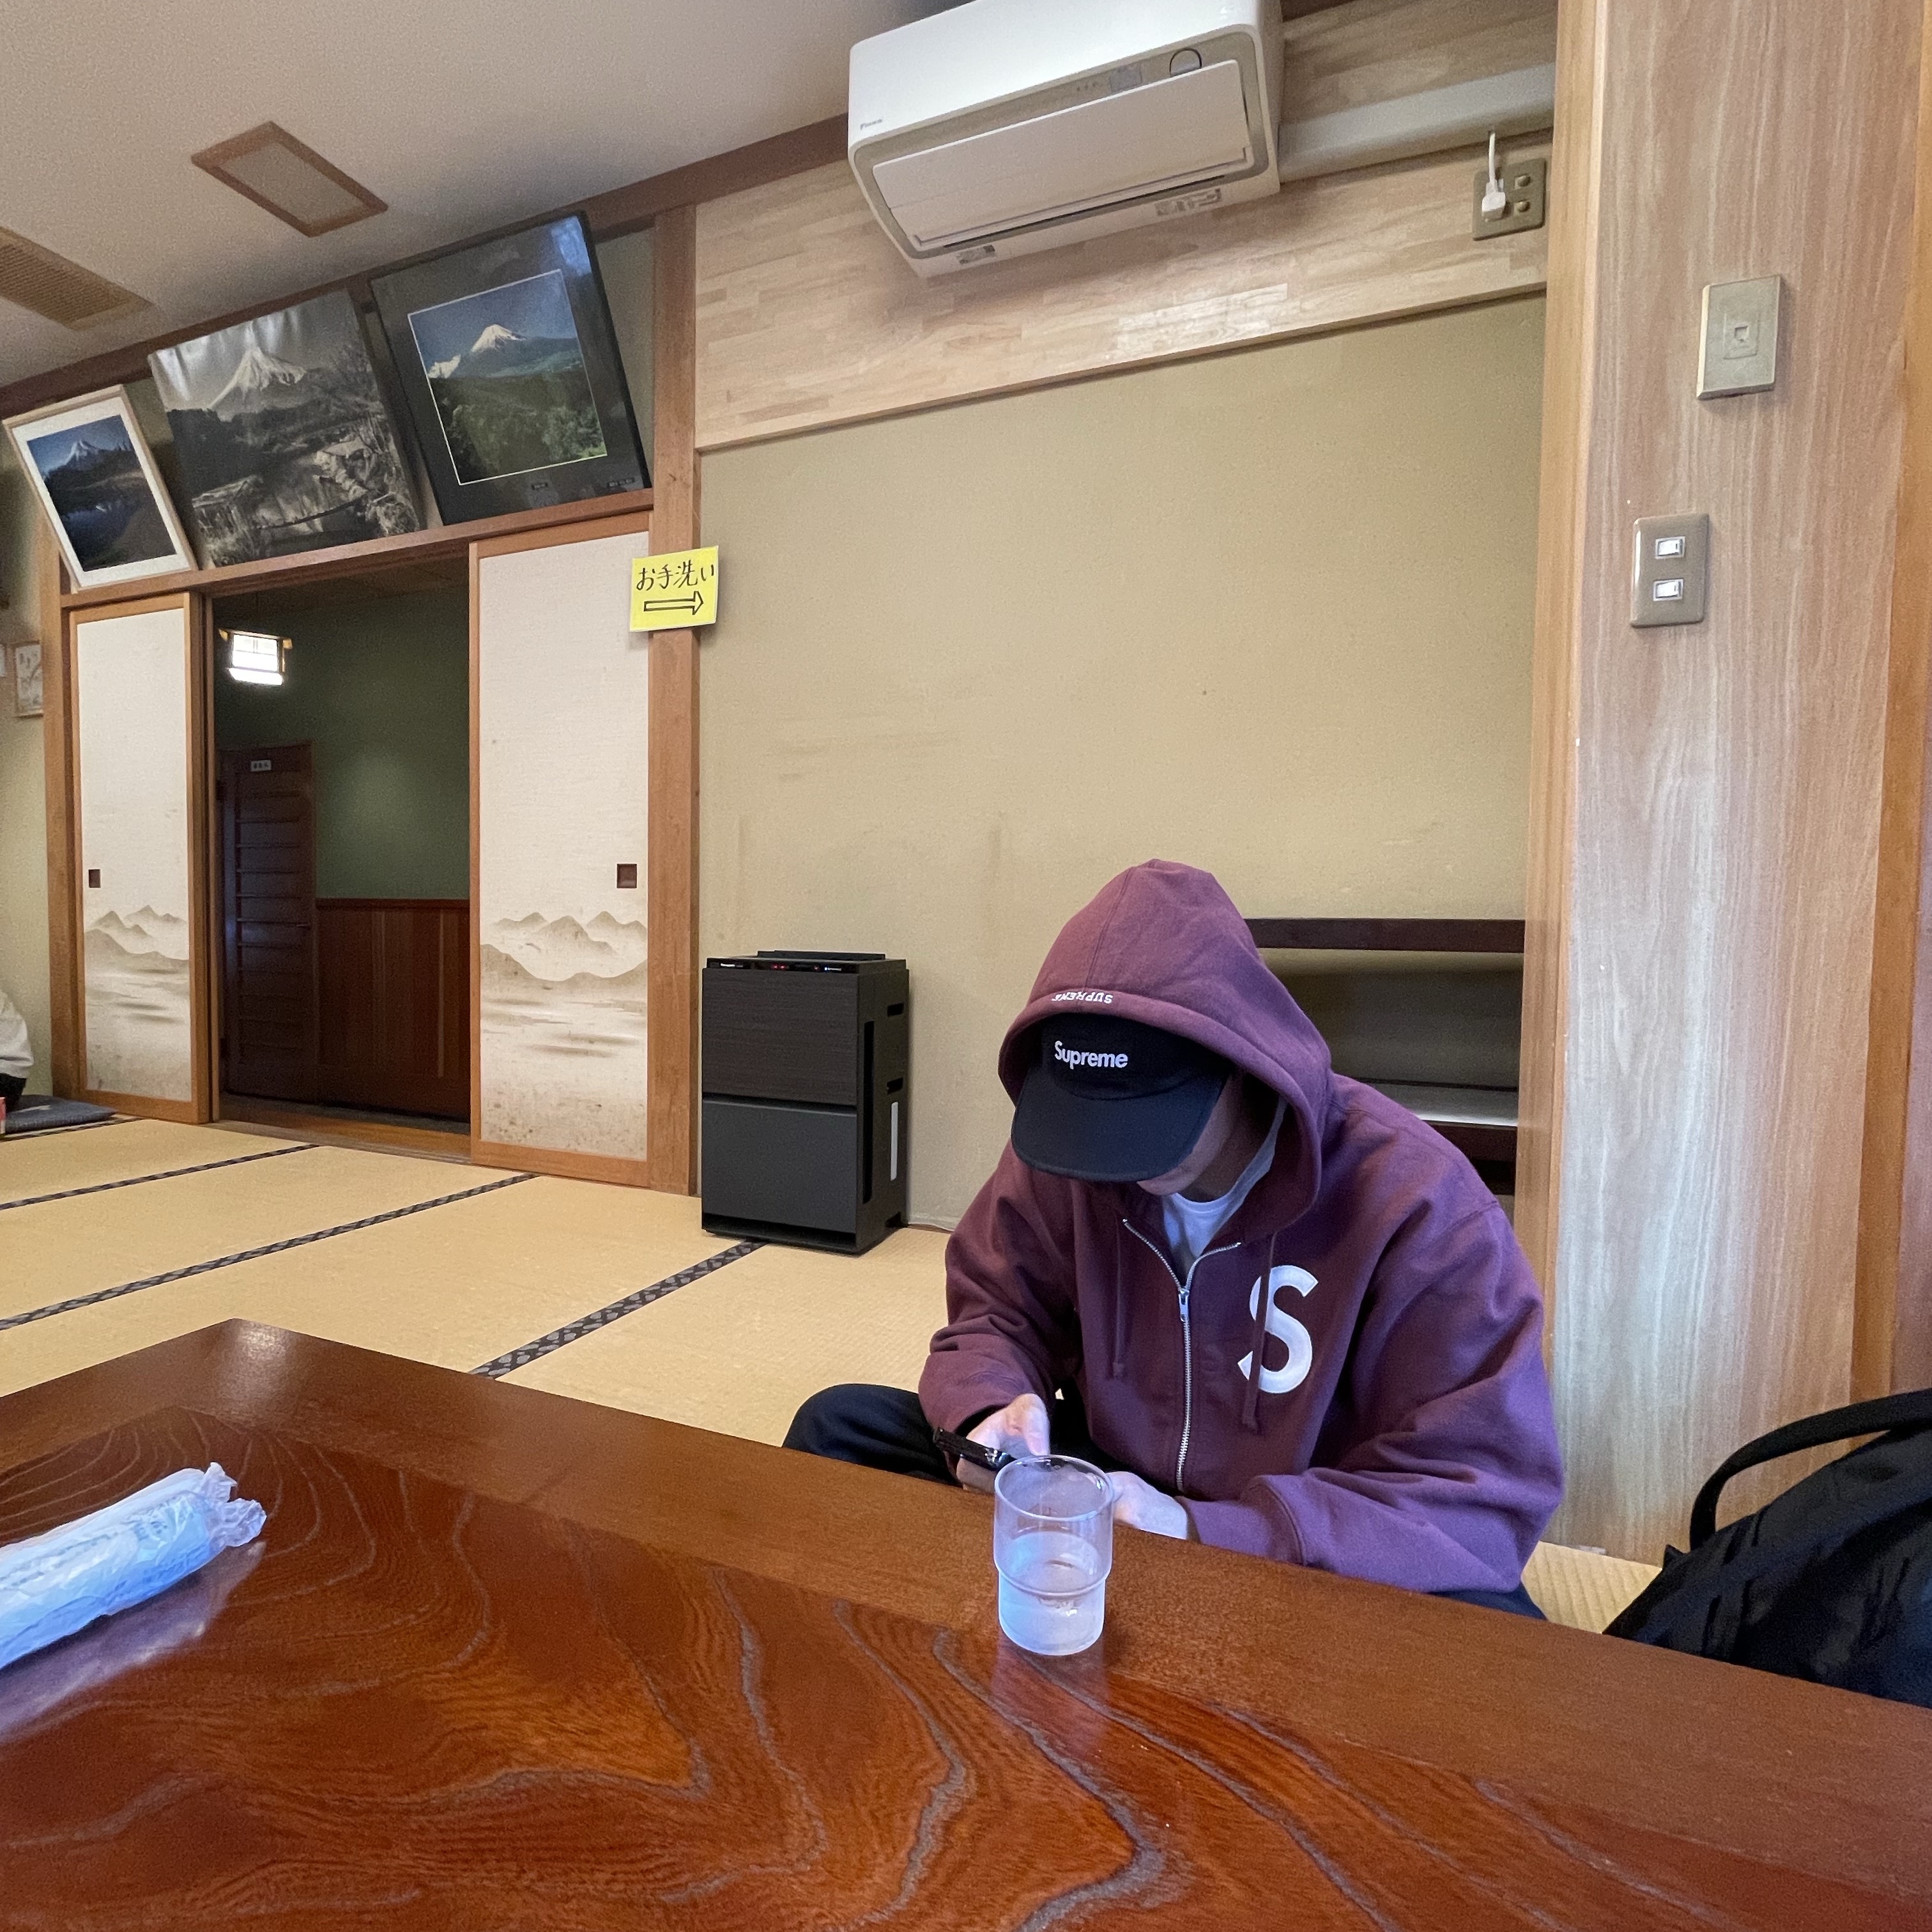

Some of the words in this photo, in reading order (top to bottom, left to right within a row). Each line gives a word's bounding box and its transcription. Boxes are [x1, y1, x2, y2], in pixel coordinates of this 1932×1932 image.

[636, 560, 714, 591] お手洗い
[1051, 991, 1114, 1004] SUPREME
[1054, 1040, 1128, 1070] Supreme
[1238, 1264, 1319, 1393] S
